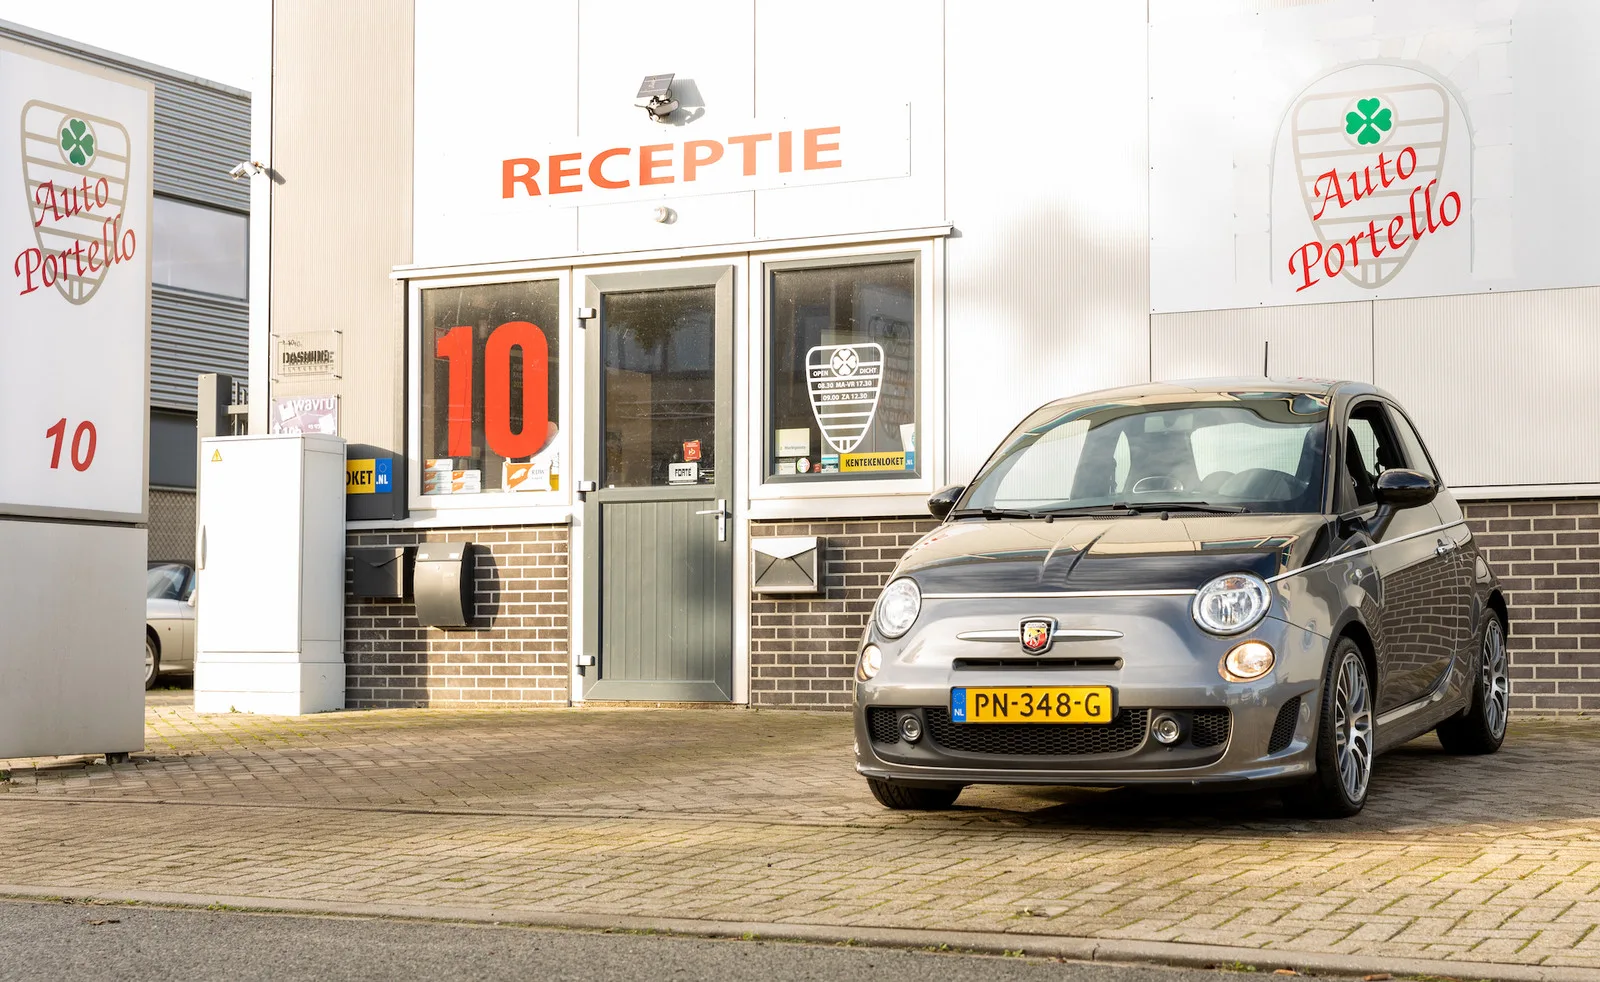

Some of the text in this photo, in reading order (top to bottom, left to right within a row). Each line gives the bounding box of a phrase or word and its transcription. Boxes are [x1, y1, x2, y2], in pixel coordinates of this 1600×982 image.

[502, 125, 842, 199] RECEPTIE
[1313, 146, 1417, 221] Auto
[34, 176, 109, 228] Auto
[14, 213, 137, 296] Portello
[1288, 178, 1462, 293] Portello
[436, 320, 549, 459] 10
[45, 417, 97, 472] 10
[845, 457, 904, 467] KENTEKENLOKET
[375, 474, 389, 485] .NL
[954, 692, 1101, 718] NL PN-348-G
